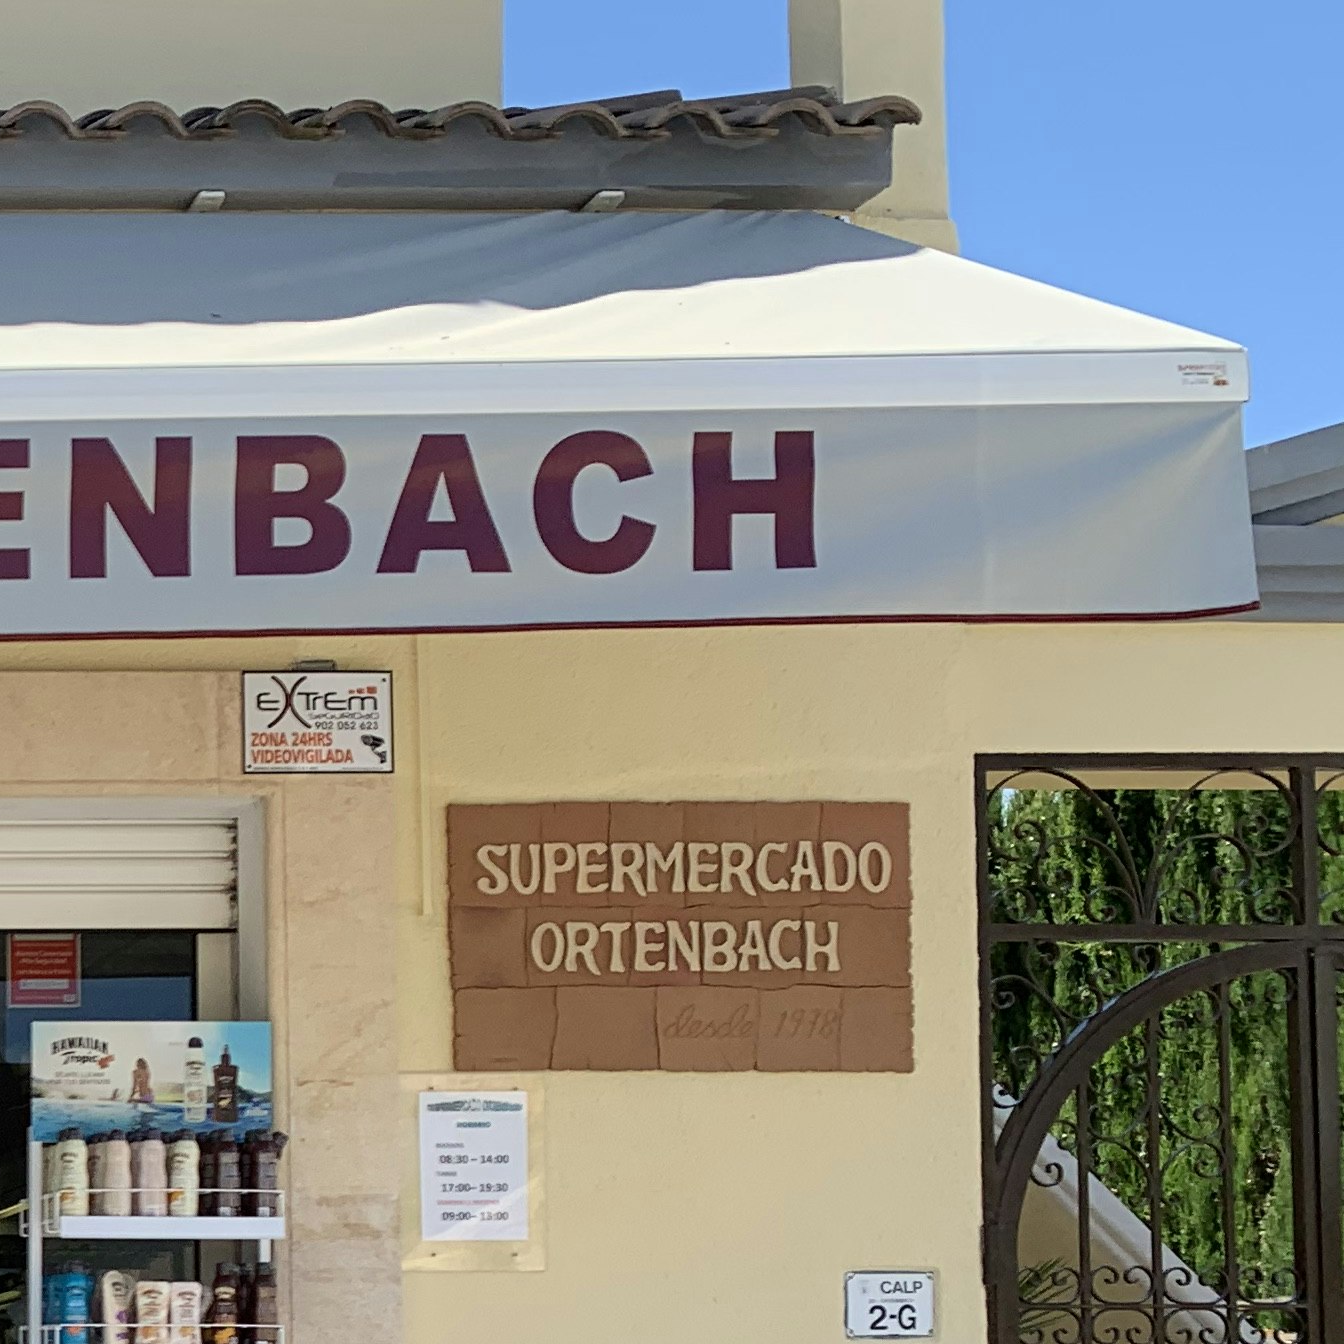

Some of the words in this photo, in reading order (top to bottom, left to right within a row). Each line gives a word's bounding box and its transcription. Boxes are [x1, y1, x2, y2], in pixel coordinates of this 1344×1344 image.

[315, 721, 333, 730] 902
[251, 732, 288, 747] ZONA
[291, 732, 333, 747] 24HRS
[251, 750, 354, 764] VIDEOVIGILADA
[475, 840, 892, 897] SUPERMERCADO
[530, 919, 842, 976] ORTENBACH
[663, 1003, 754, 1040] desde
[50, 1036, 109, 1055] HAWAIIAN
[880, 1281, 923, 1294] CALP
[869, 1304, 917, 1330] 2-G
